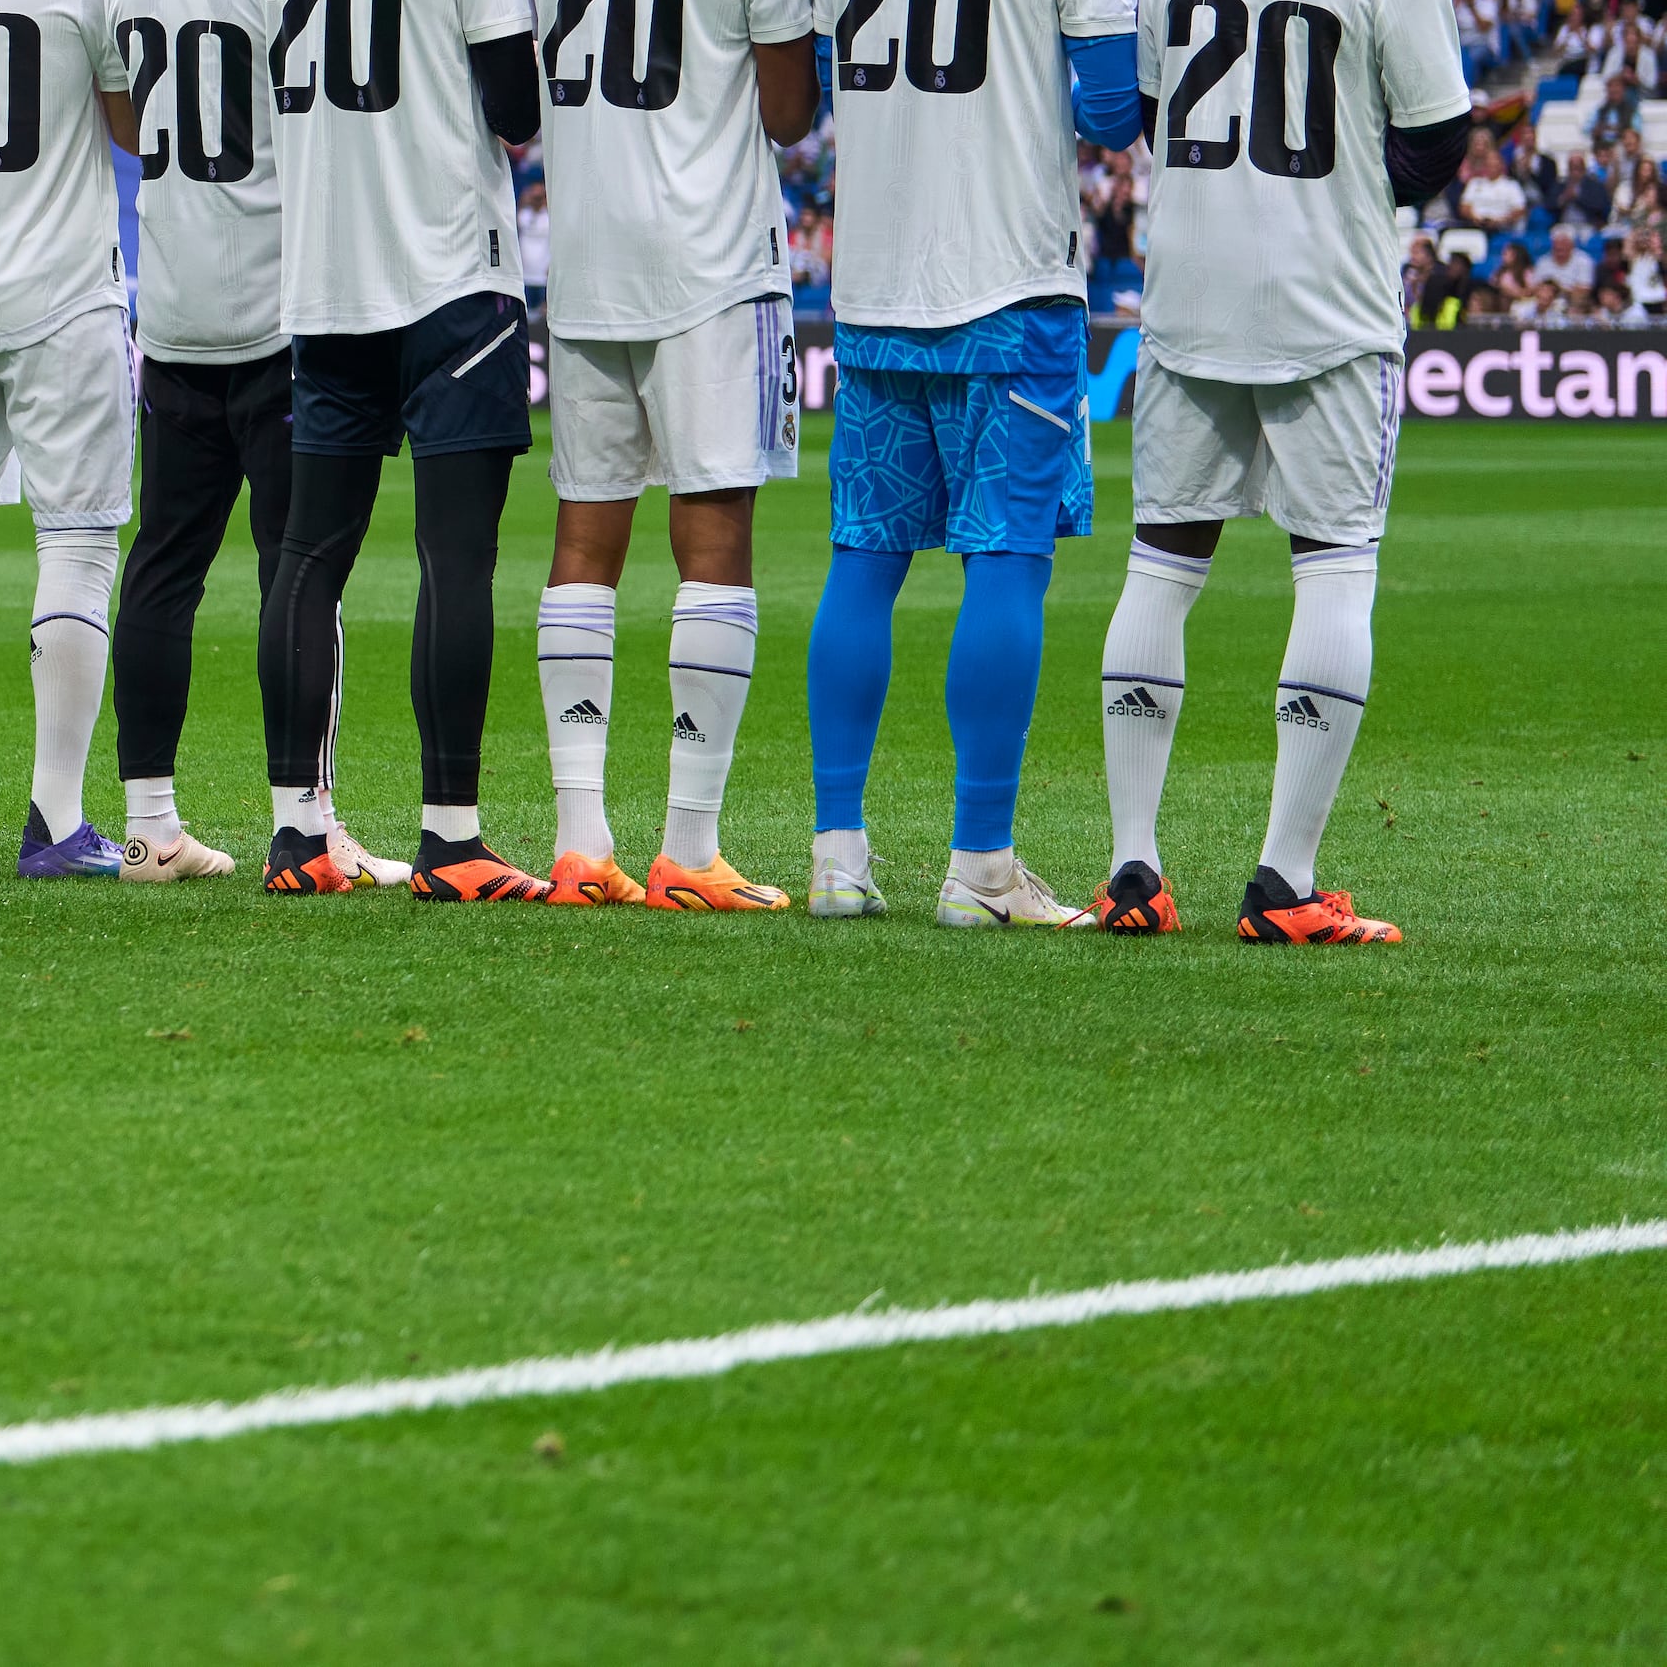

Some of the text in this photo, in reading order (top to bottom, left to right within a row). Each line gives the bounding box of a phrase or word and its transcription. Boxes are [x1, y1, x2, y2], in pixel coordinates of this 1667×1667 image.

[115, 17, 254, 183] 20
[559, 712, 608, 726] adidas
[1107, 705, 1167, 721] adidas
[1275, 710, 1330, 732] adidas
